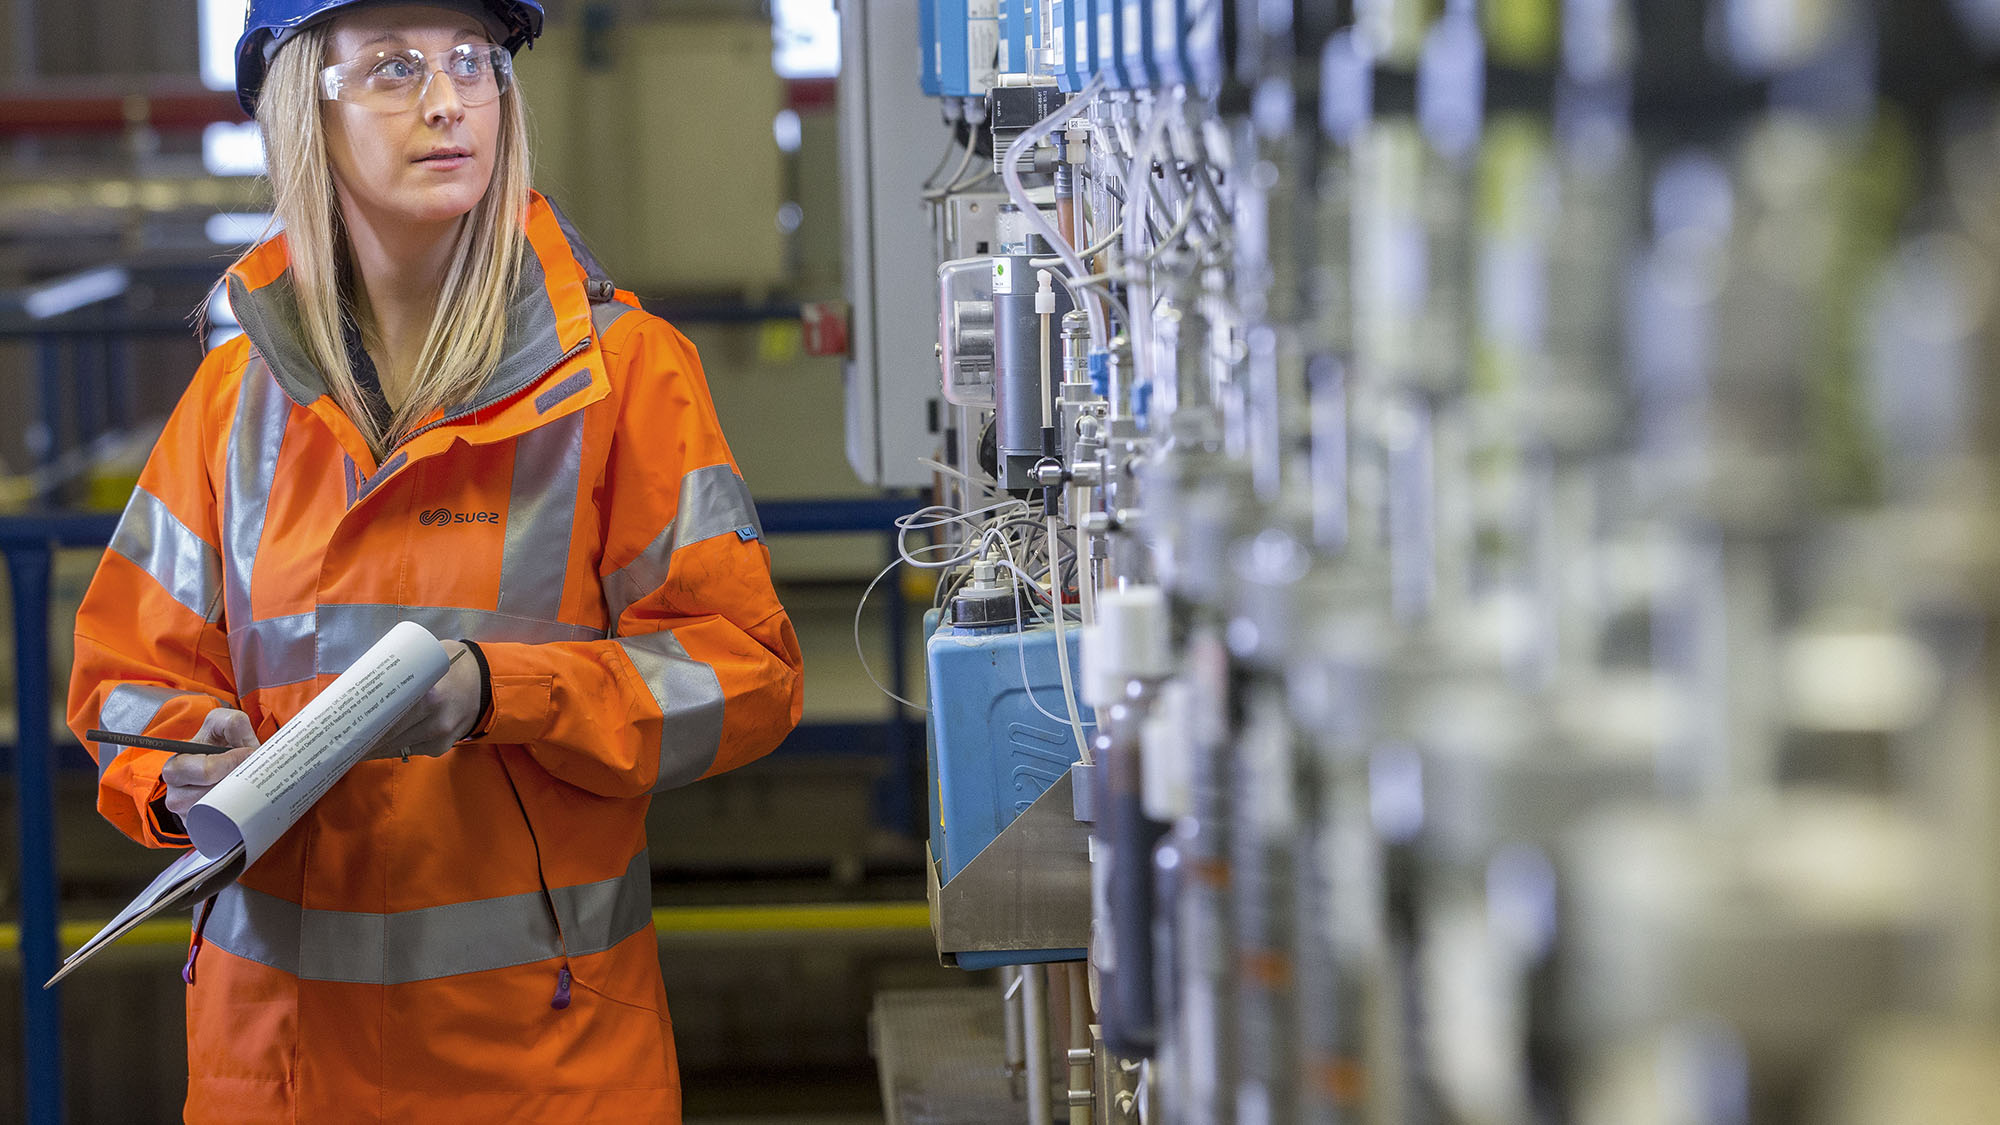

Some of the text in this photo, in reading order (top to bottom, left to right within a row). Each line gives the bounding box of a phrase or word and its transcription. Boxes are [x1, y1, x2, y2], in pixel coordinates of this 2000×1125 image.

[319, 713, 333, 726] within
[337, 695, 355, 712] portfolio
[359, 669, 386, 693] photographic
[384, 656, 402, 673] images
[255, 771, 276, 790] produced
[277, 751, 299, 771] November
[303, 728, 326, 749] December
[332, 706, 353, 726] featuring
[264, 780, 285, 799] Pursuant
[302, 743, 330, 768] consideration
[363, 701, 381, 718] (receipt
[384, 686, 398, 700] which
[399, 672, 417, 688] hereby
